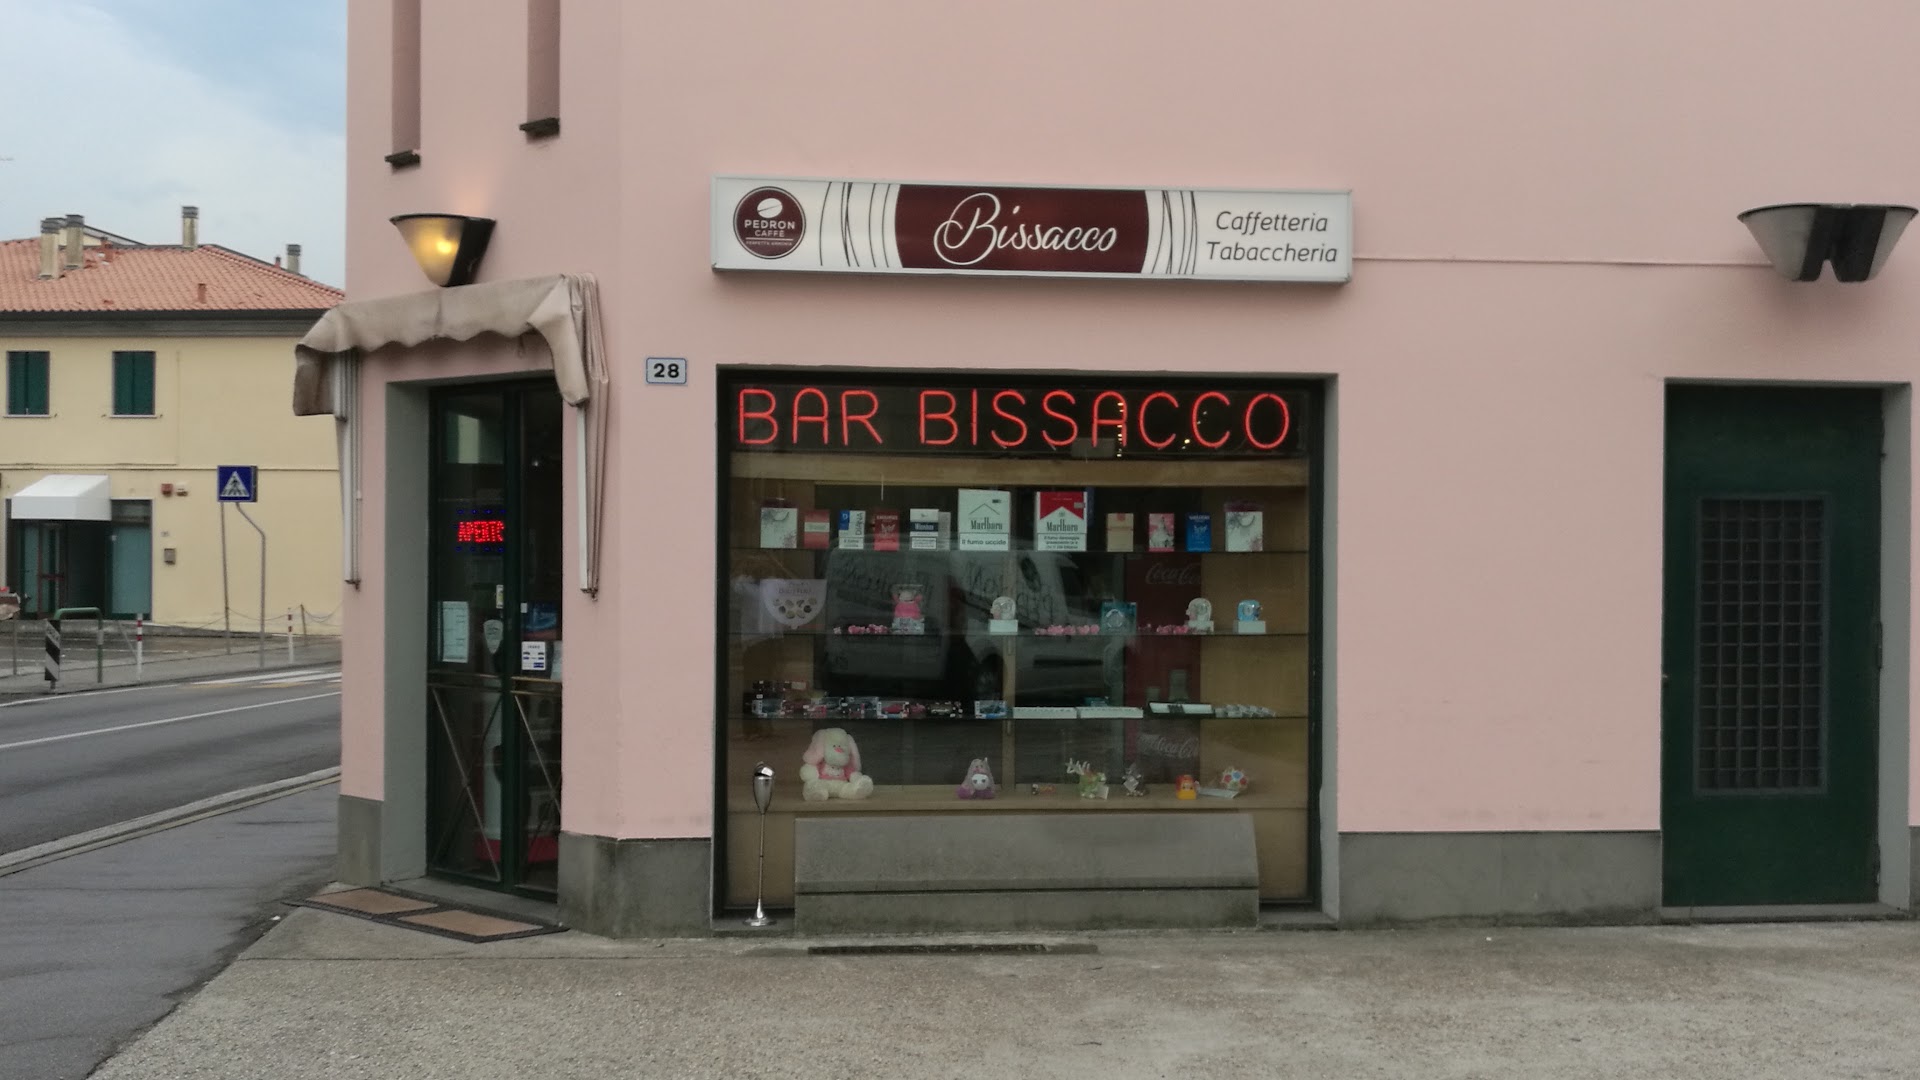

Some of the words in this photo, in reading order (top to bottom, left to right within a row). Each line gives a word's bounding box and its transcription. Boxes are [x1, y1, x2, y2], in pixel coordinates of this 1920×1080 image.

[744, 219, 796, 230] PEDRON
[933, 192, 1117, 265] Bissacco
[1216, 211, 1328, 235] Caffetteria
[1206, 241, 1338, 262] Tabaccheria
[653, 362, 680, 379] 28
[739, 388, 883, 445] BAR
[918, 388, 1290, 449] BISSACCO
[970, 517, 1003, 530] Marlboro
[1046, 519, 1079, 532] Marlboro
